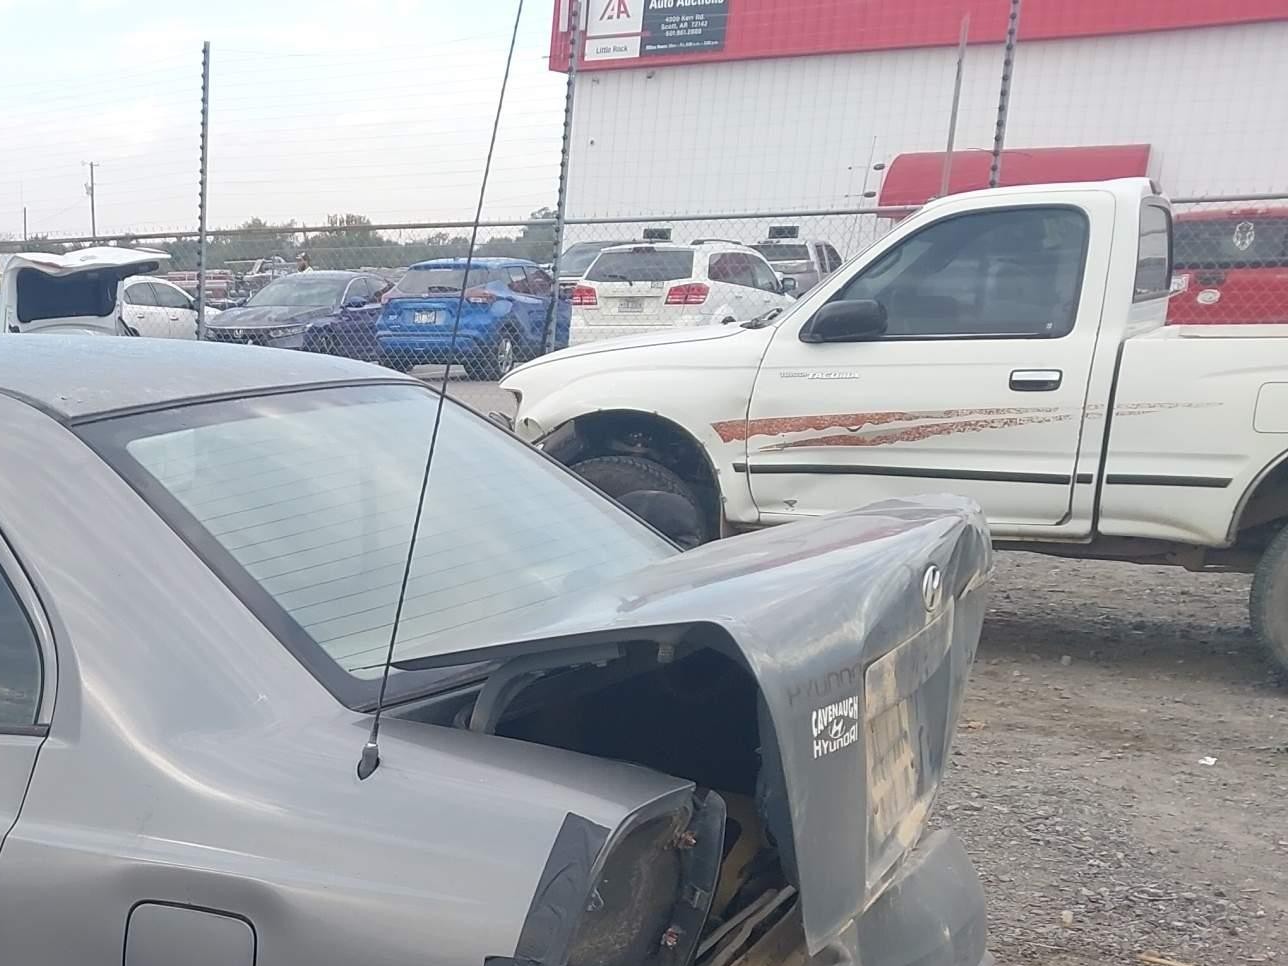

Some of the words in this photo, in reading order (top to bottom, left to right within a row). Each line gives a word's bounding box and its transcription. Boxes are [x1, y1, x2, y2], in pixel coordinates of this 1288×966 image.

[648, 0, 674, 9] Auto
[812, 695, 859, 738] CAVENAUGH
[813, 720, 858, 760] HYUNDAI
